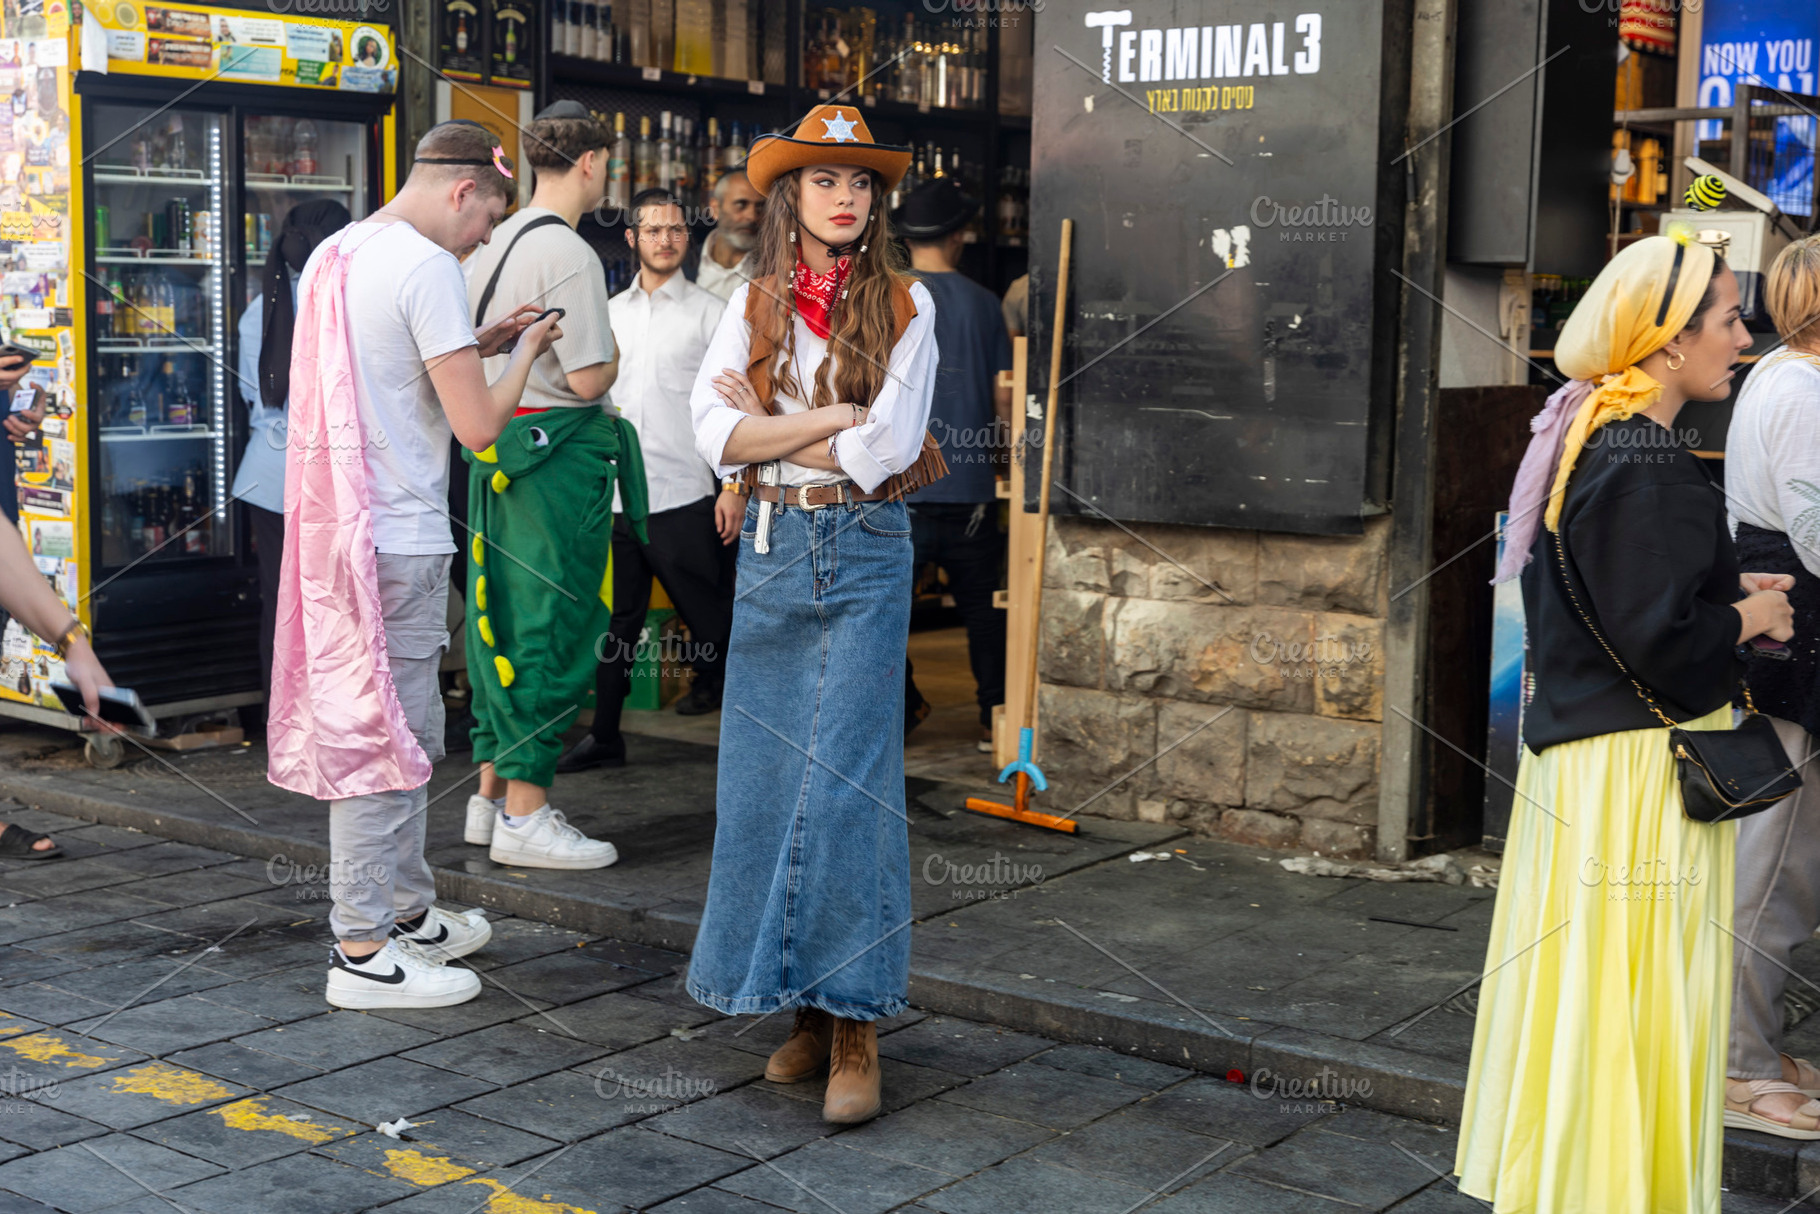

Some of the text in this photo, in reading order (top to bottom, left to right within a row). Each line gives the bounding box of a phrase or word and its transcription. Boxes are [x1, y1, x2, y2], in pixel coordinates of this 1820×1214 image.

[1703, 38, 1812, 76] NOW YOU
[1145, 88, 1179, 115] בארץ
[1181, 84, 1219, 113] לקנות
